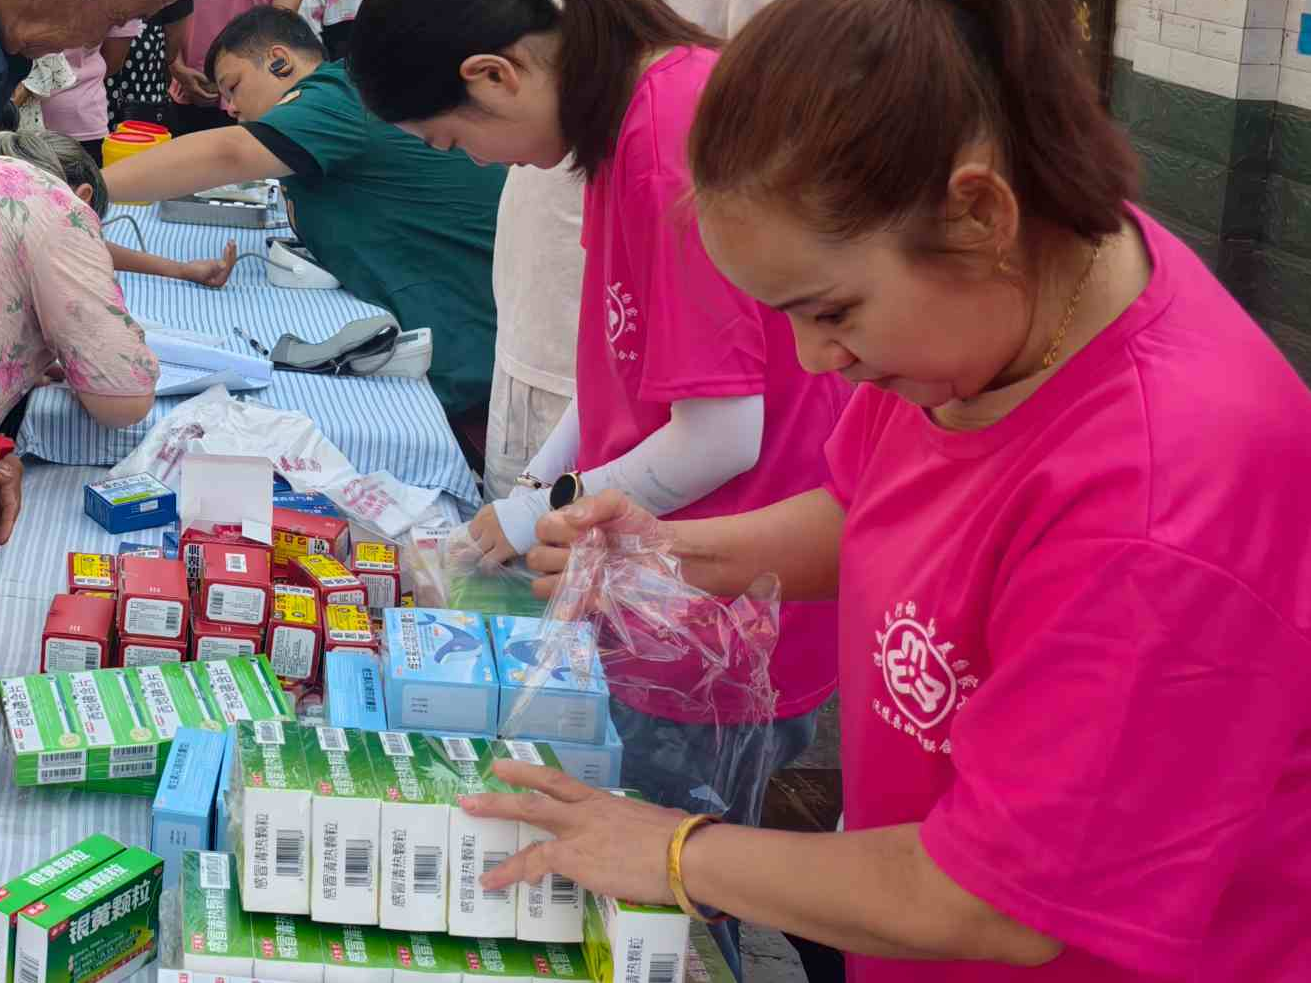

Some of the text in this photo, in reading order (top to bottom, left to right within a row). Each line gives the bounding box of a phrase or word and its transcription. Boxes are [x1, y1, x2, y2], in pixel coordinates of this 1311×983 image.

[254, 813, 269, 889] 感冒清热颗粒
[323, 821, 338, 900] 感冒清热颗粒
[391, 828, 407, 908] 感冒清热颗粒
[459, 833, 476, 913] 感冒清热颗粒
[69, 880, 150, 945] 银黄颗粒
